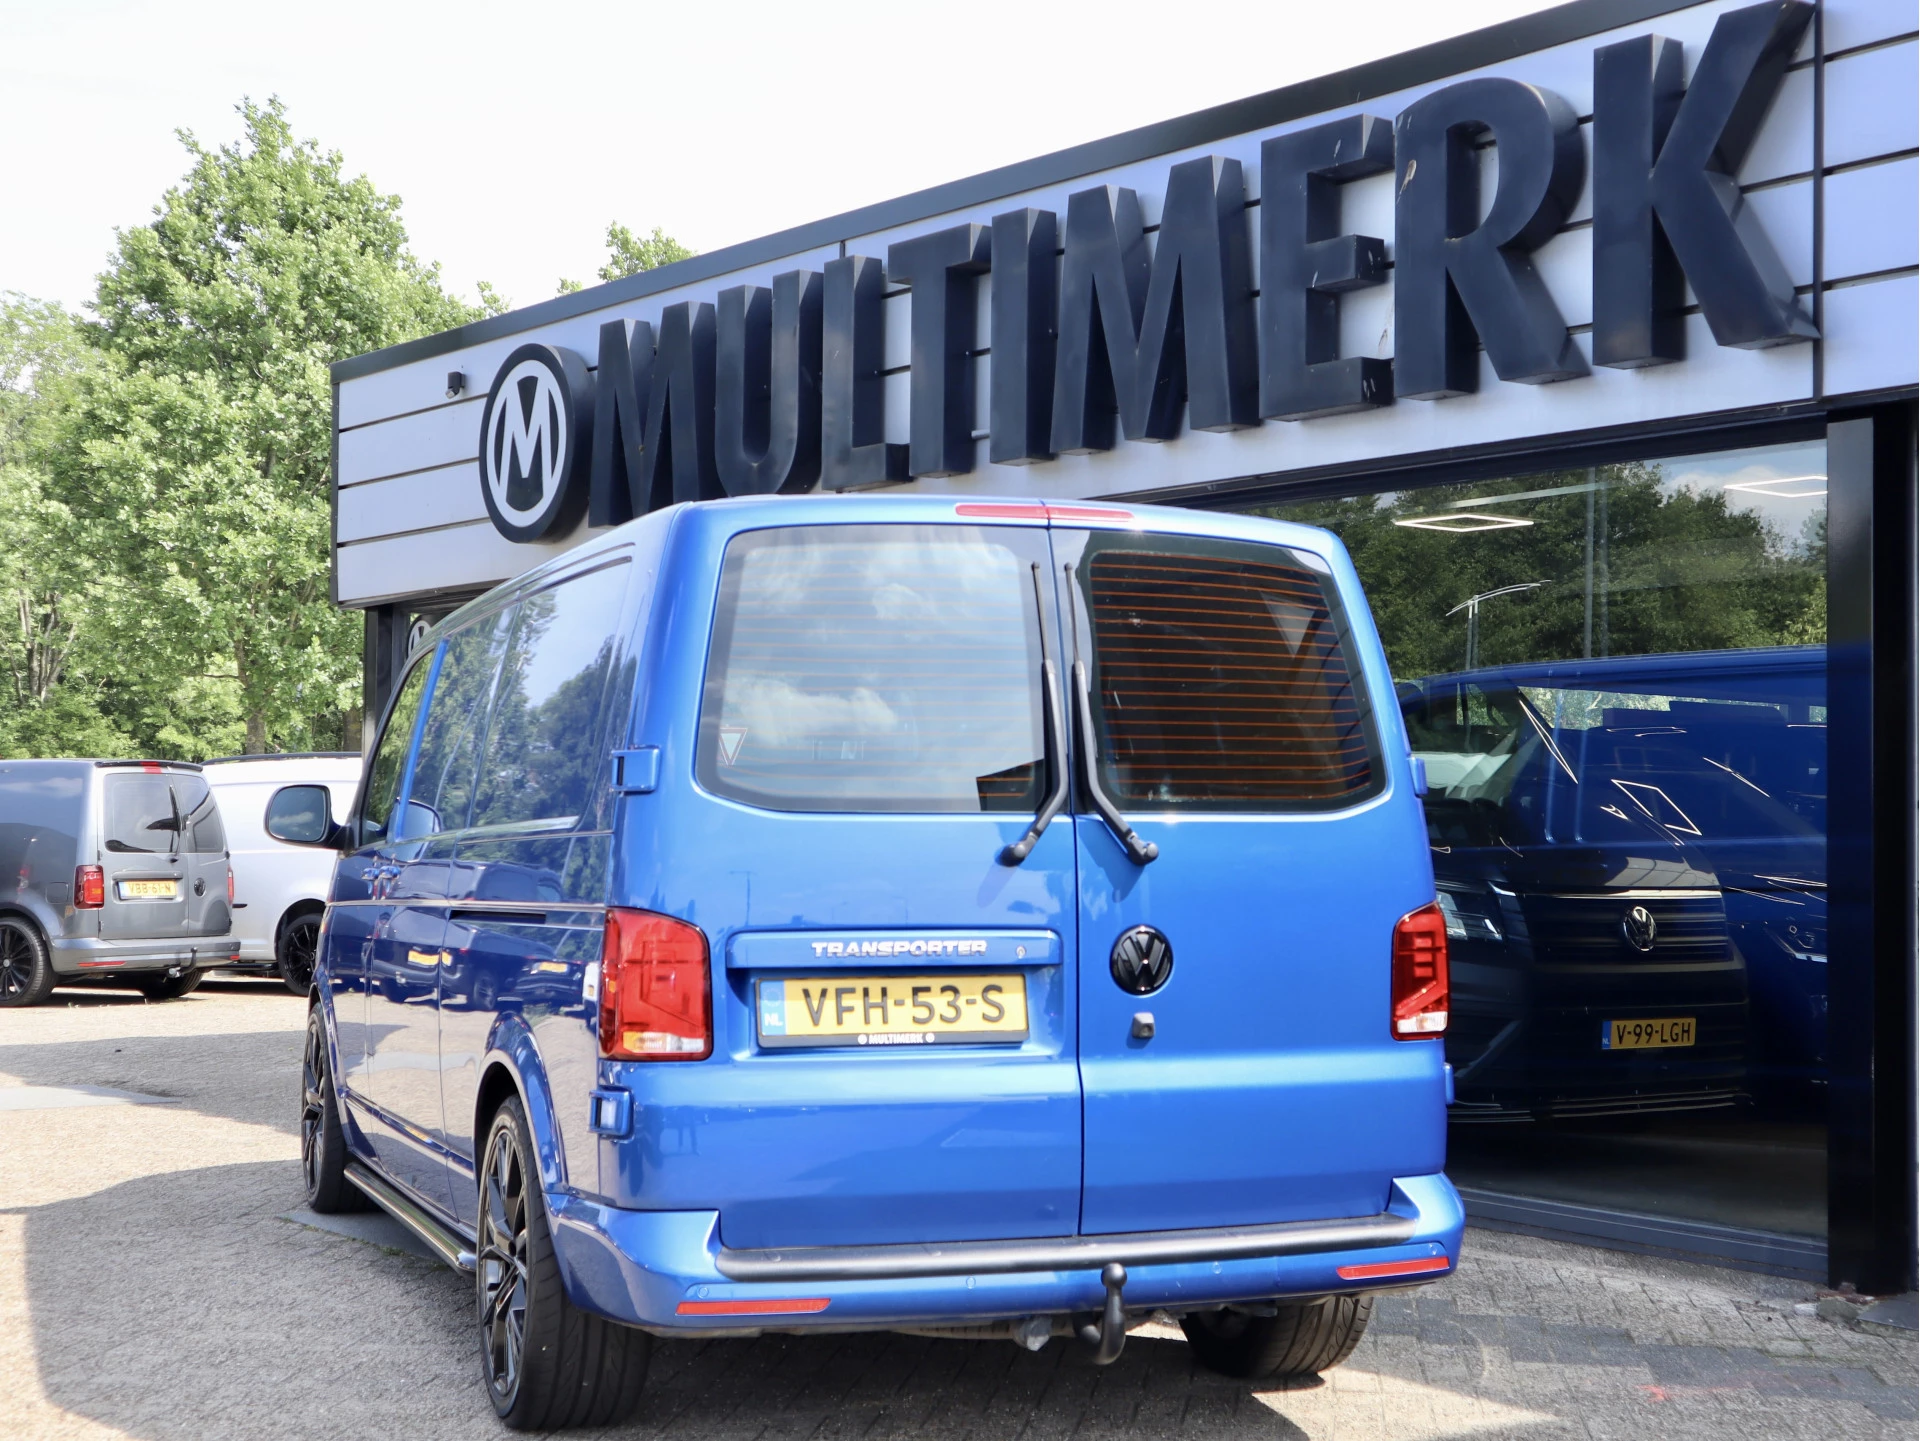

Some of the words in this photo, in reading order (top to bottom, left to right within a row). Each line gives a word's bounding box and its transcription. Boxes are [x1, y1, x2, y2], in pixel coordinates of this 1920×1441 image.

[590, 0, 1818, 527] MULTIMERK
[811, 940, 988, 958] TRANSPORTER
[764, 1013, 783, 1026] NL
[802, 985, 1006, 1026] VFH-53-S
[868, 1033, 924, 1045] MULTIMERK
[1617, 1022, 1691, 1044] V-99-LGH
